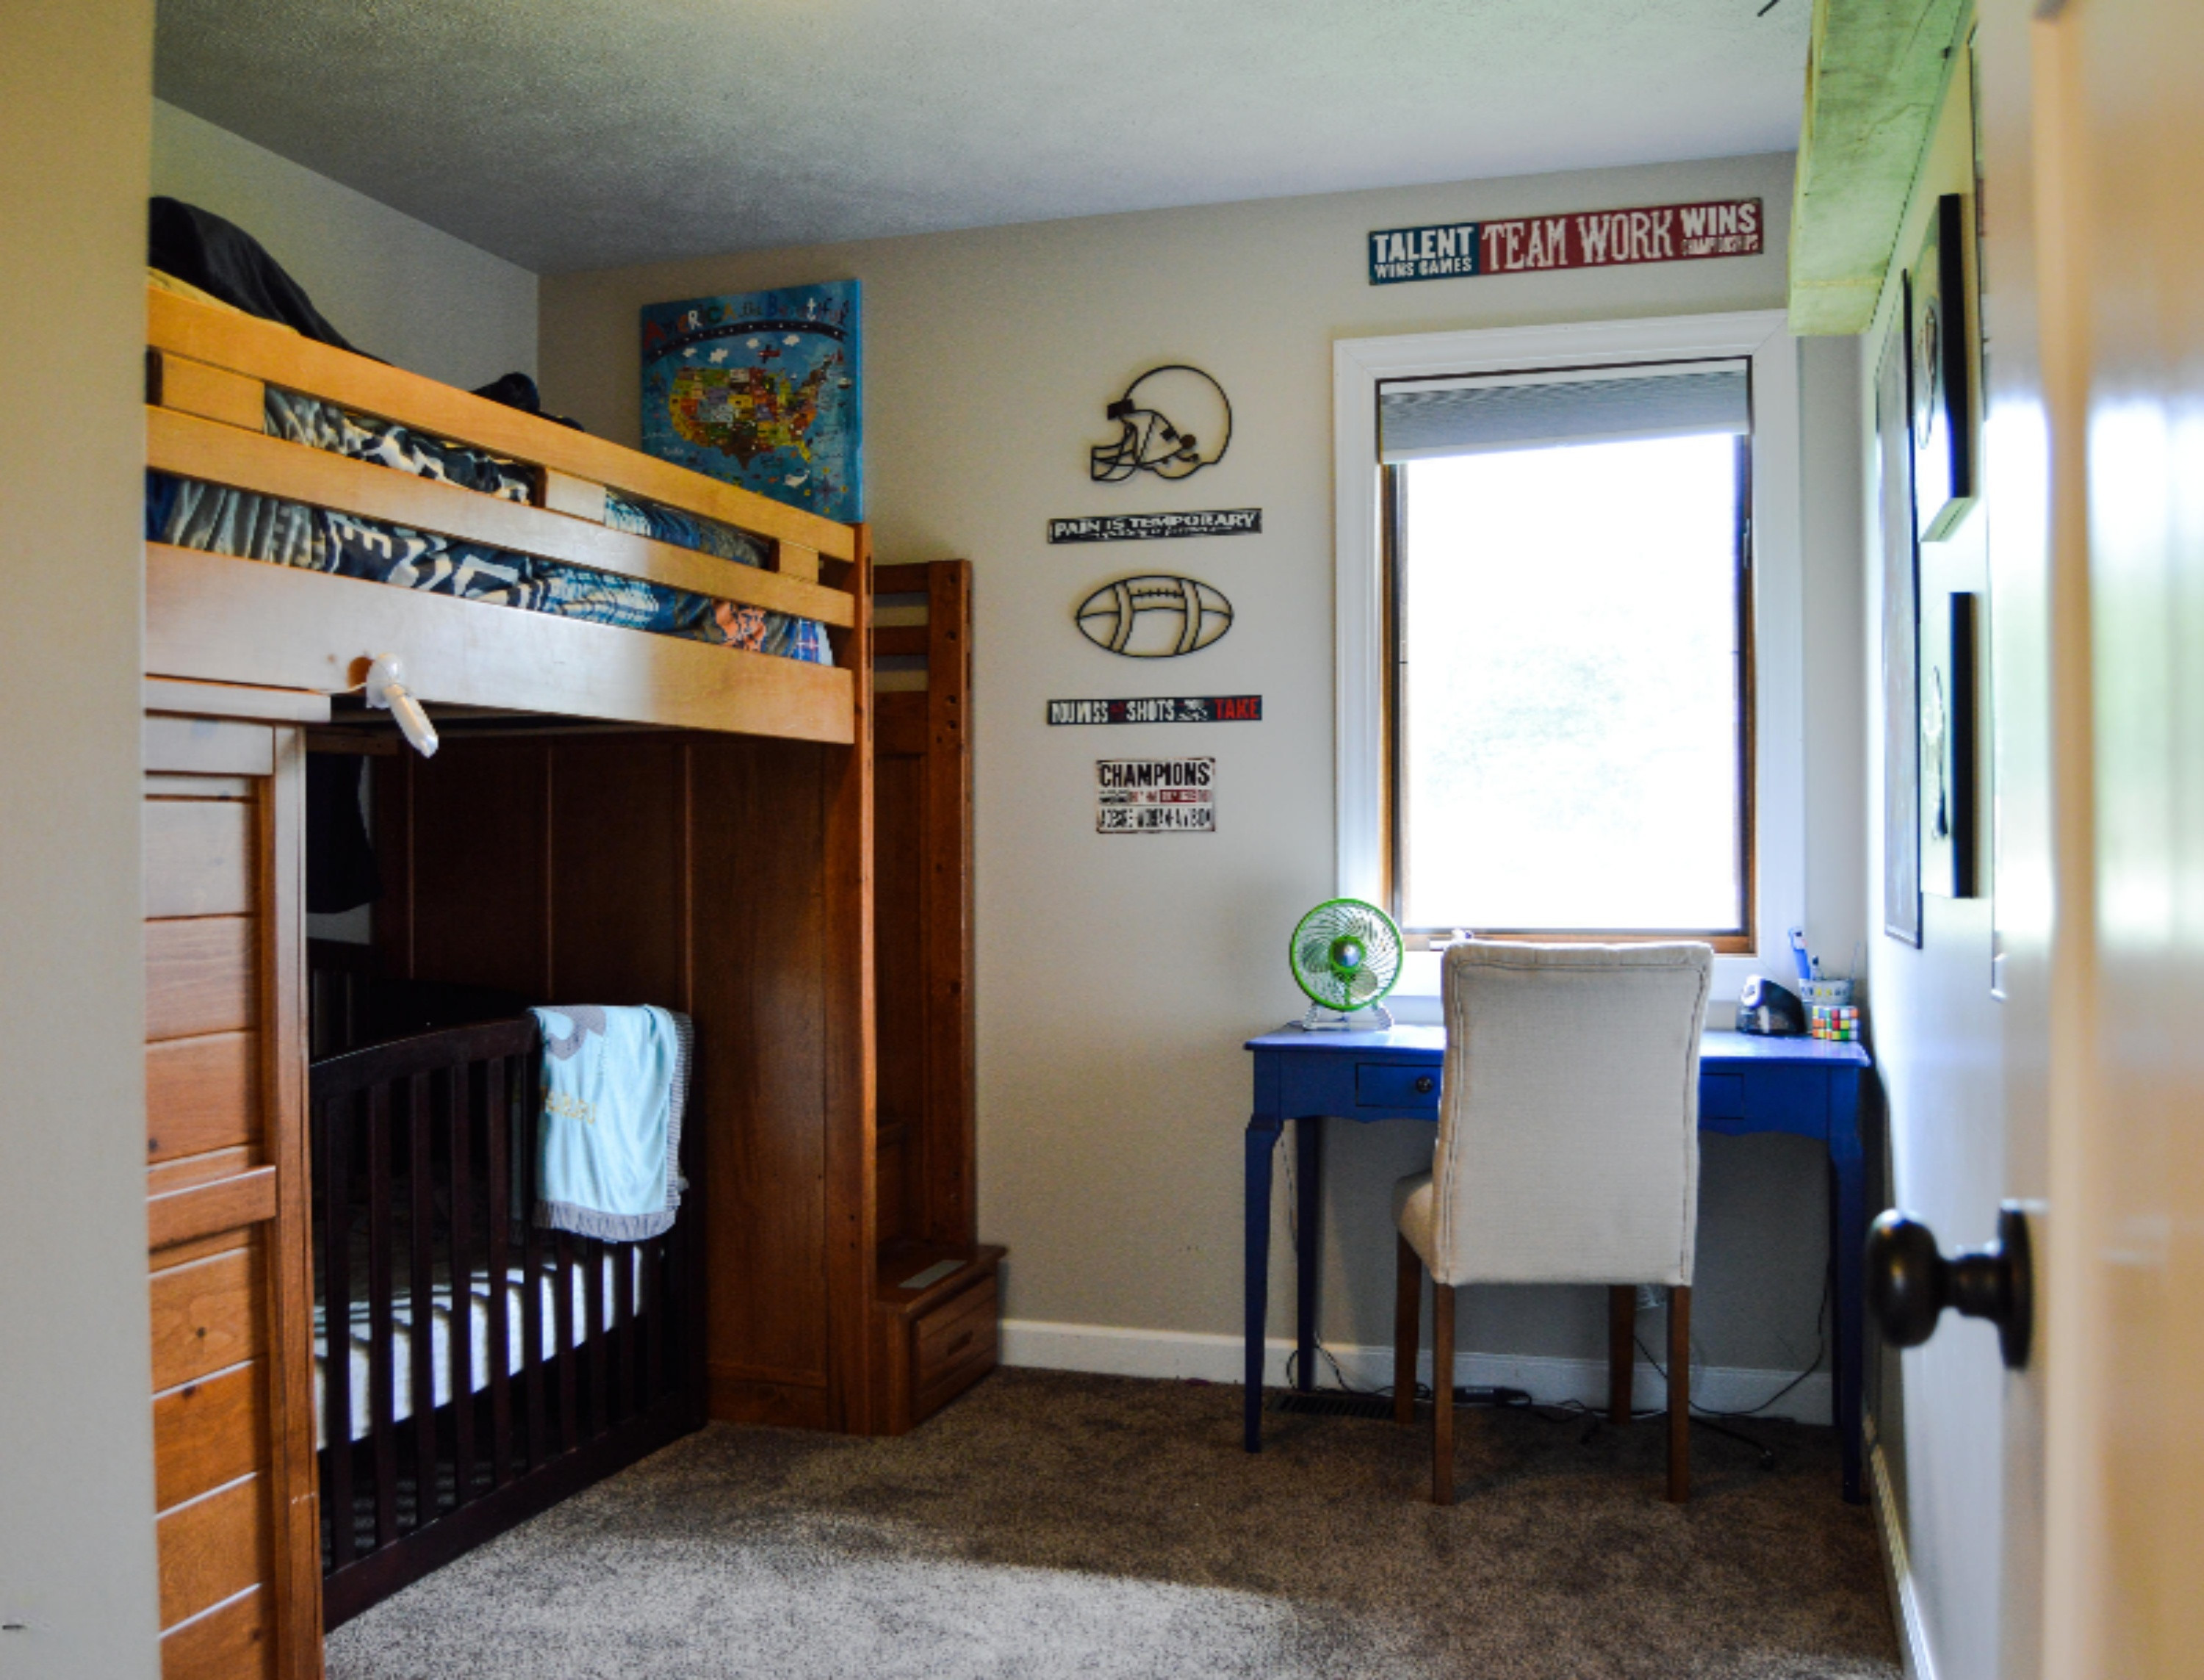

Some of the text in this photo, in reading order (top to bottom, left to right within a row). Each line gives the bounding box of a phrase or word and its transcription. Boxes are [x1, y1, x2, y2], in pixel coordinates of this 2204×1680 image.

[1680, 203, 1757, 237] WINS
[1372, 226, 1474, 263] TALENT
[1482, 209, 1674, 271] TEAM WORK
[1374, 257, 1472, 278] WINS GAMES
[1054, 520, 1099, 538] PAIN
[1106, 519, 1124, 530] IS
[1129, 512, 1257, 528] TEMPORARY
[1126, 699, 1175, 721] SHOTS
[1214, 697, 1259, 719] TAKE
[1100, 762, 1211, 787] CHAMPIONS
